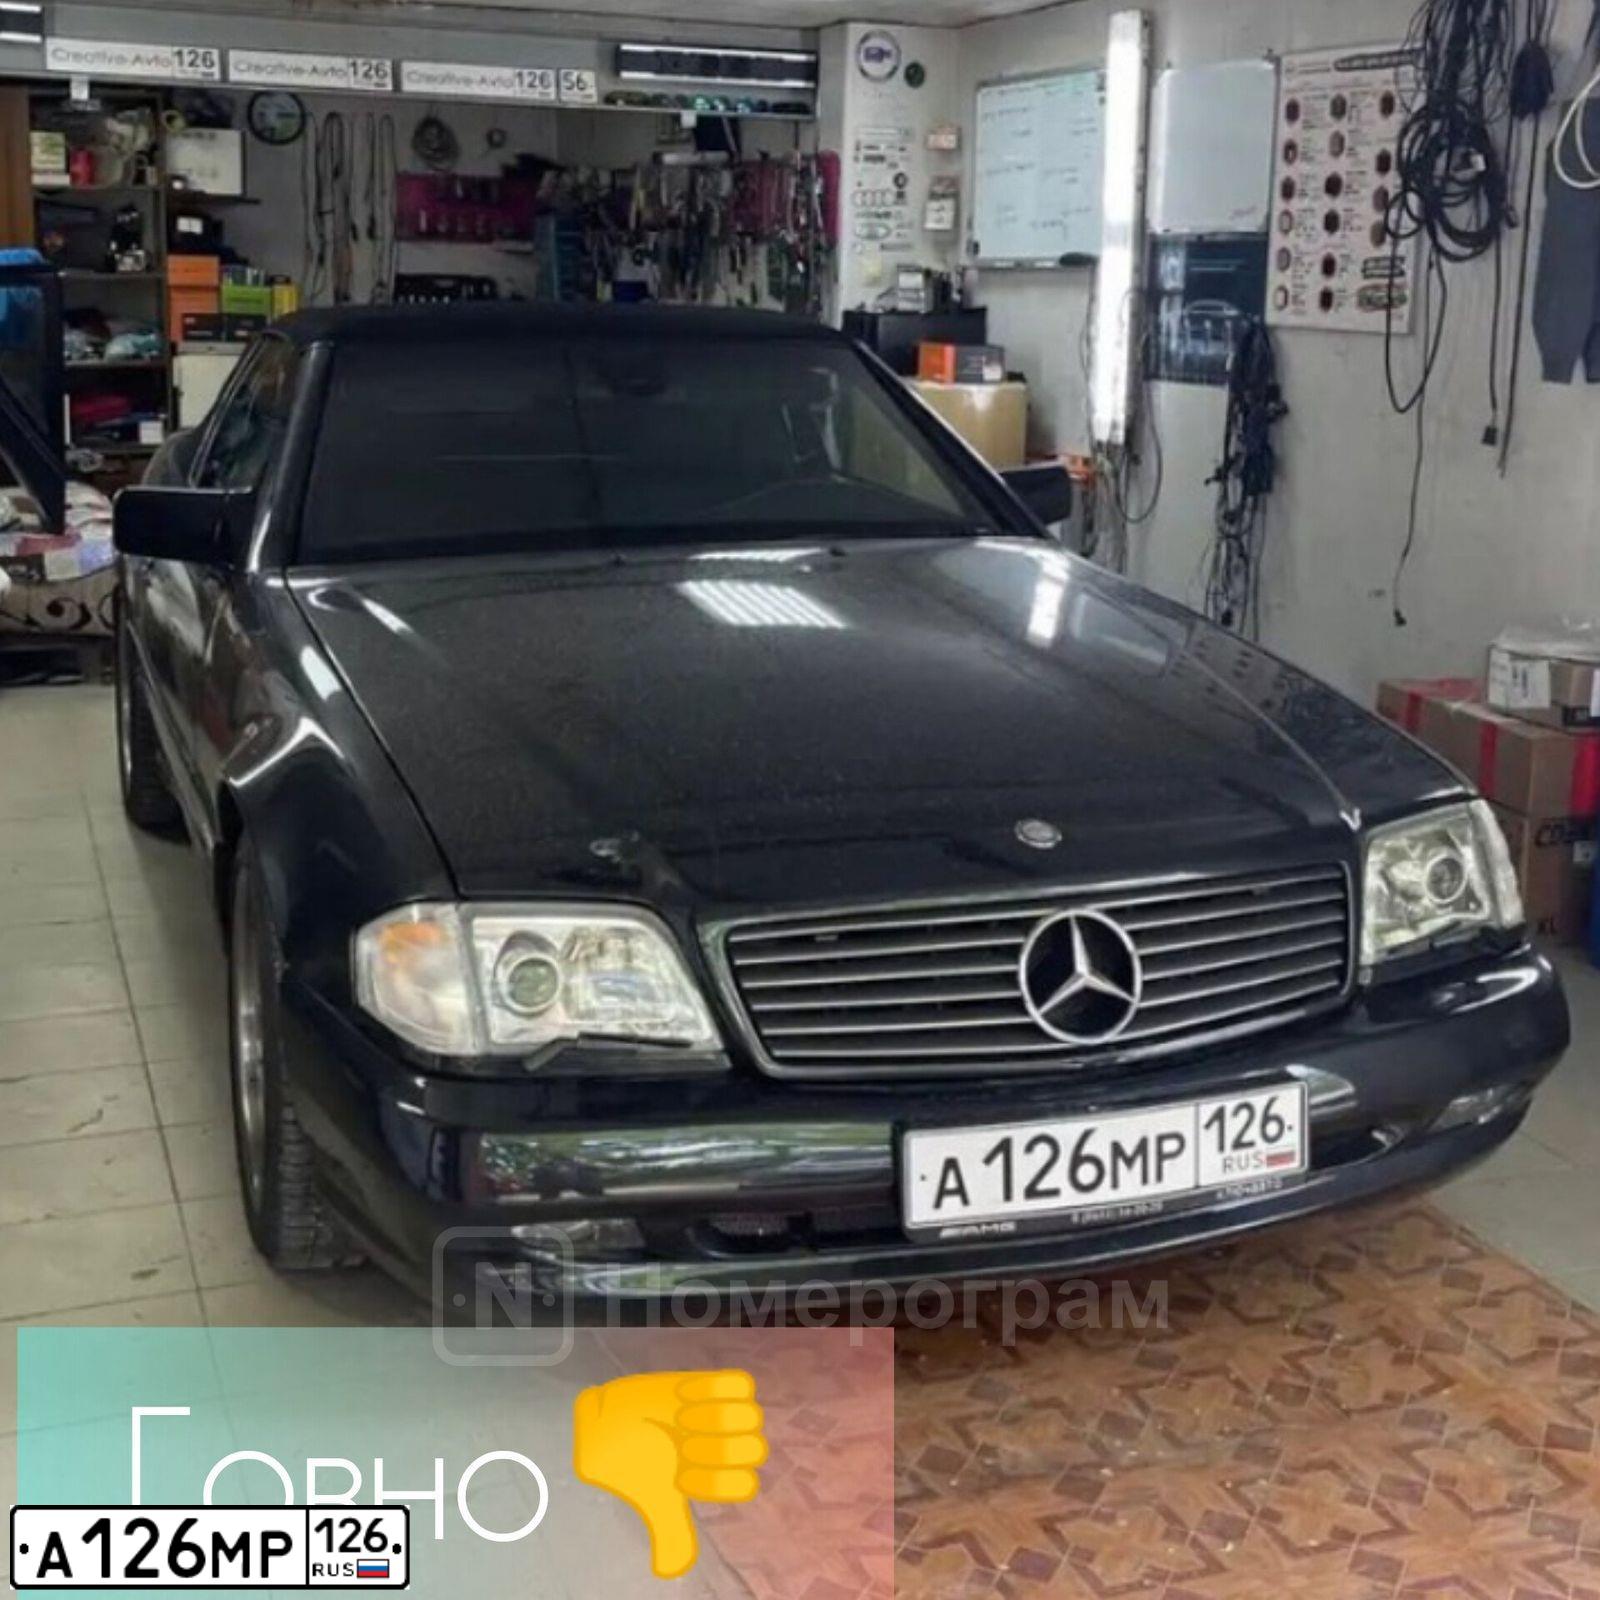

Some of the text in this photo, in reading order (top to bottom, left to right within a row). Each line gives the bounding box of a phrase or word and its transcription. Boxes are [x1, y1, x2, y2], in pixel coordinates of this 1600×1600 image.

[174, 49, 215, 69] 126
[350, 60, 388, 79] 126
[1204, 1096, 1285, 1154] 126
[1222, 1151, 1264, 1174] RUS
